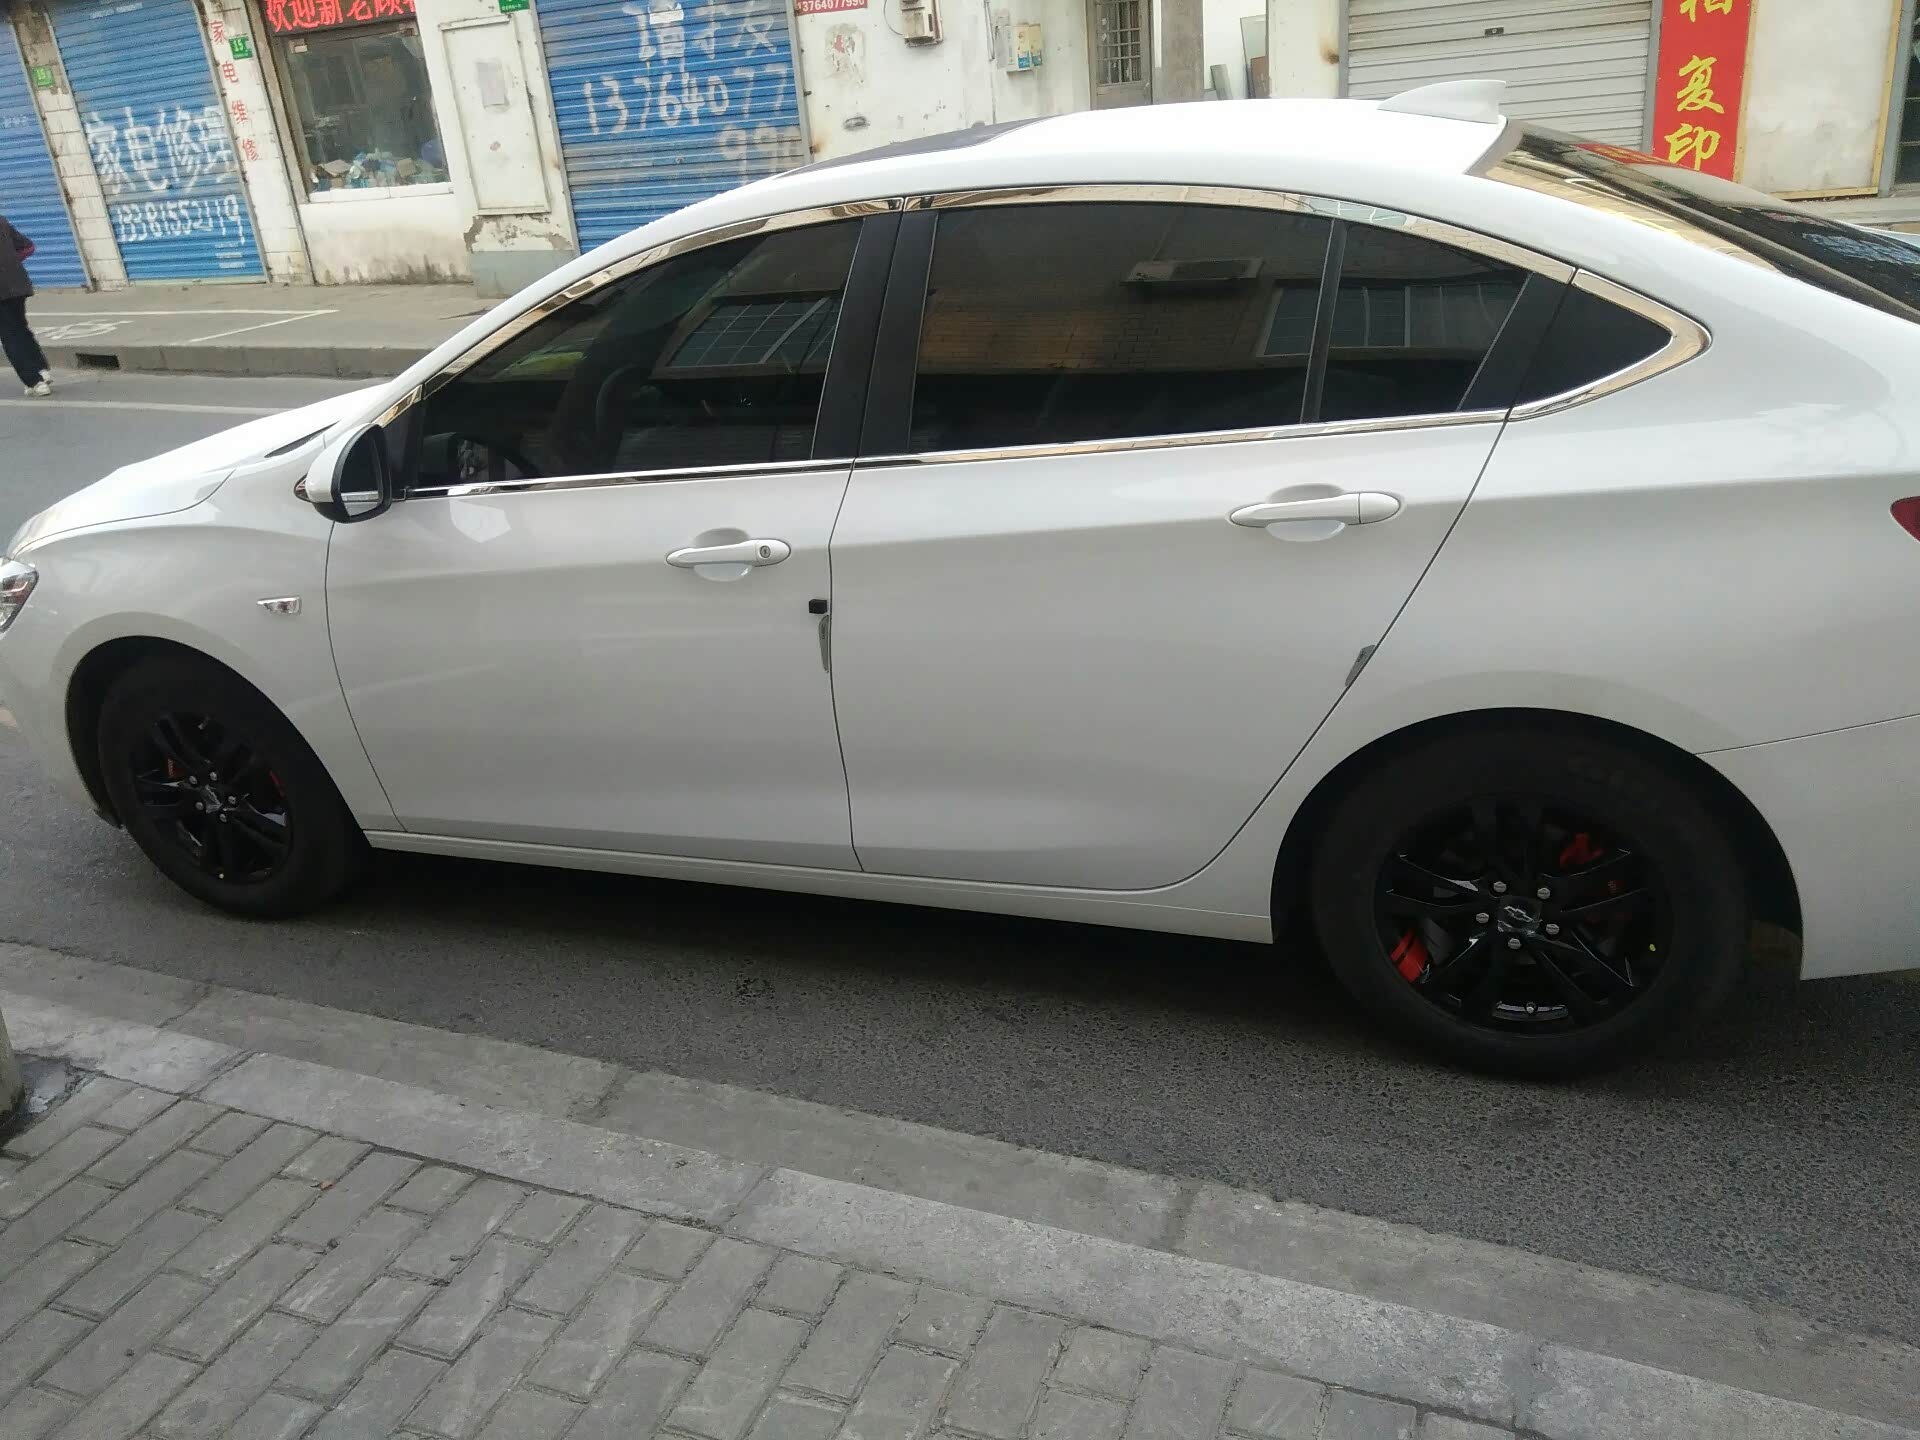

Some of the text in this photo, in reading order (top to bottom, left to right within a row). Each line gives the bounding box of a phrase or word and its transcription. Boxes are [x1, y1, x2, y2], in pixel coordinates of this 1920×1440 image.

[209, 20, 258, 161] 家电维修
[583, 63, 788, 135] 13764077
